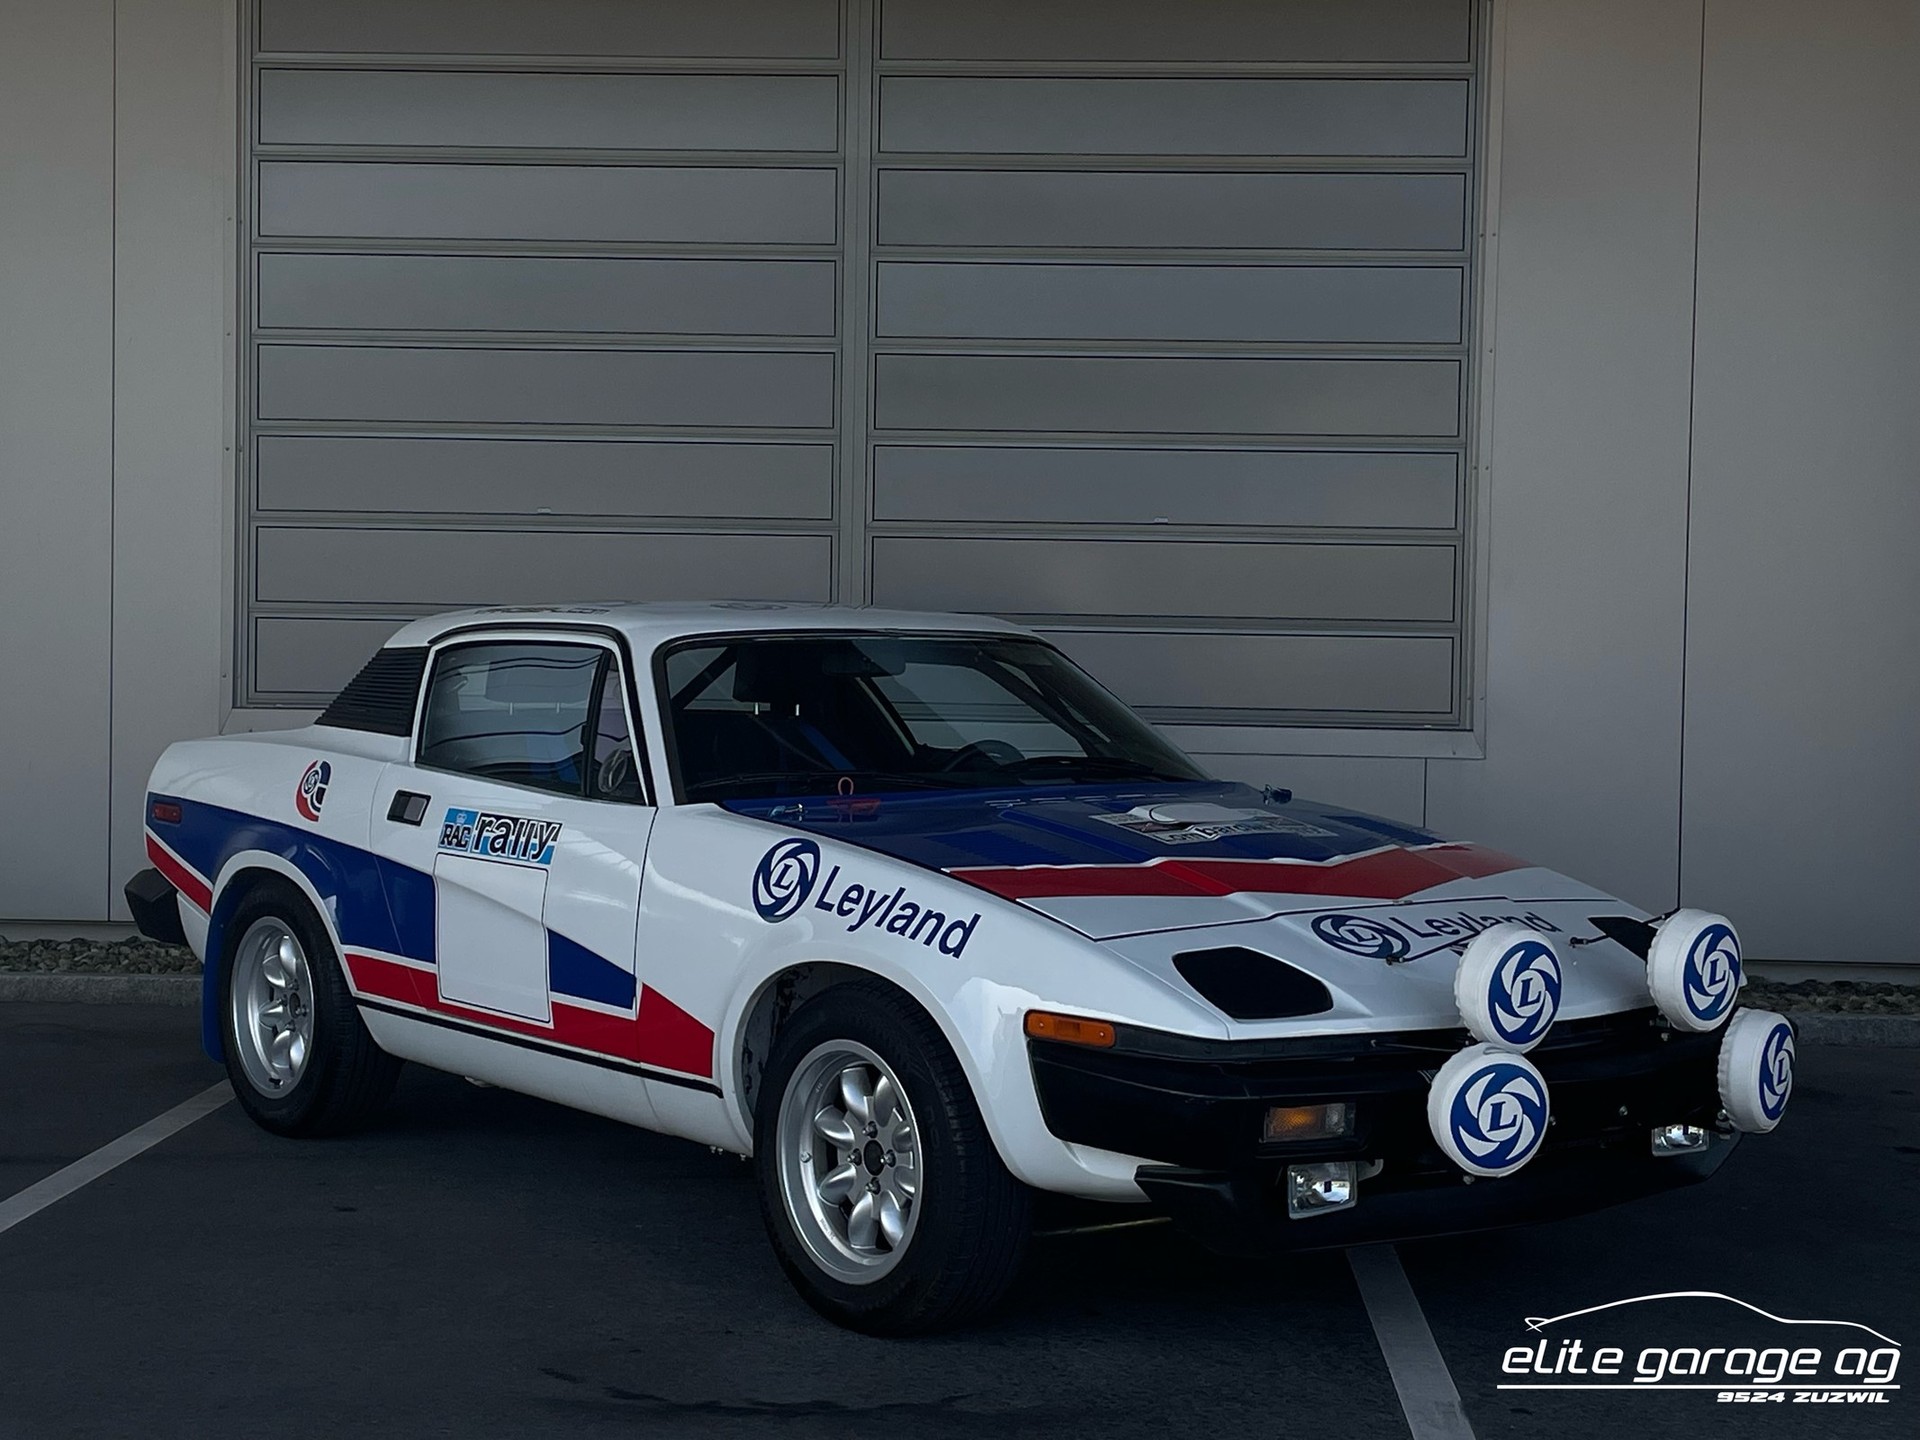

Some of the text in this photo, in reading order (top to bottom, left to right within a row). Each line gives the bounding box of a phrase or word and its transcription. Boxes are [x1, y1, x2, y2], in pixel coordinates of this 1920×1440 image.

[440, 817, 560, 861] RAC rally
[772, 863, 794, 890] L
[814, 865, 982, 959] Leyland
[1709, 958, 1726, 988] L
[1517, 977, 1542, 1008] L
[1776, 1057, 1787, 1087] L
[1487, 1101, 1518, 1133] L
